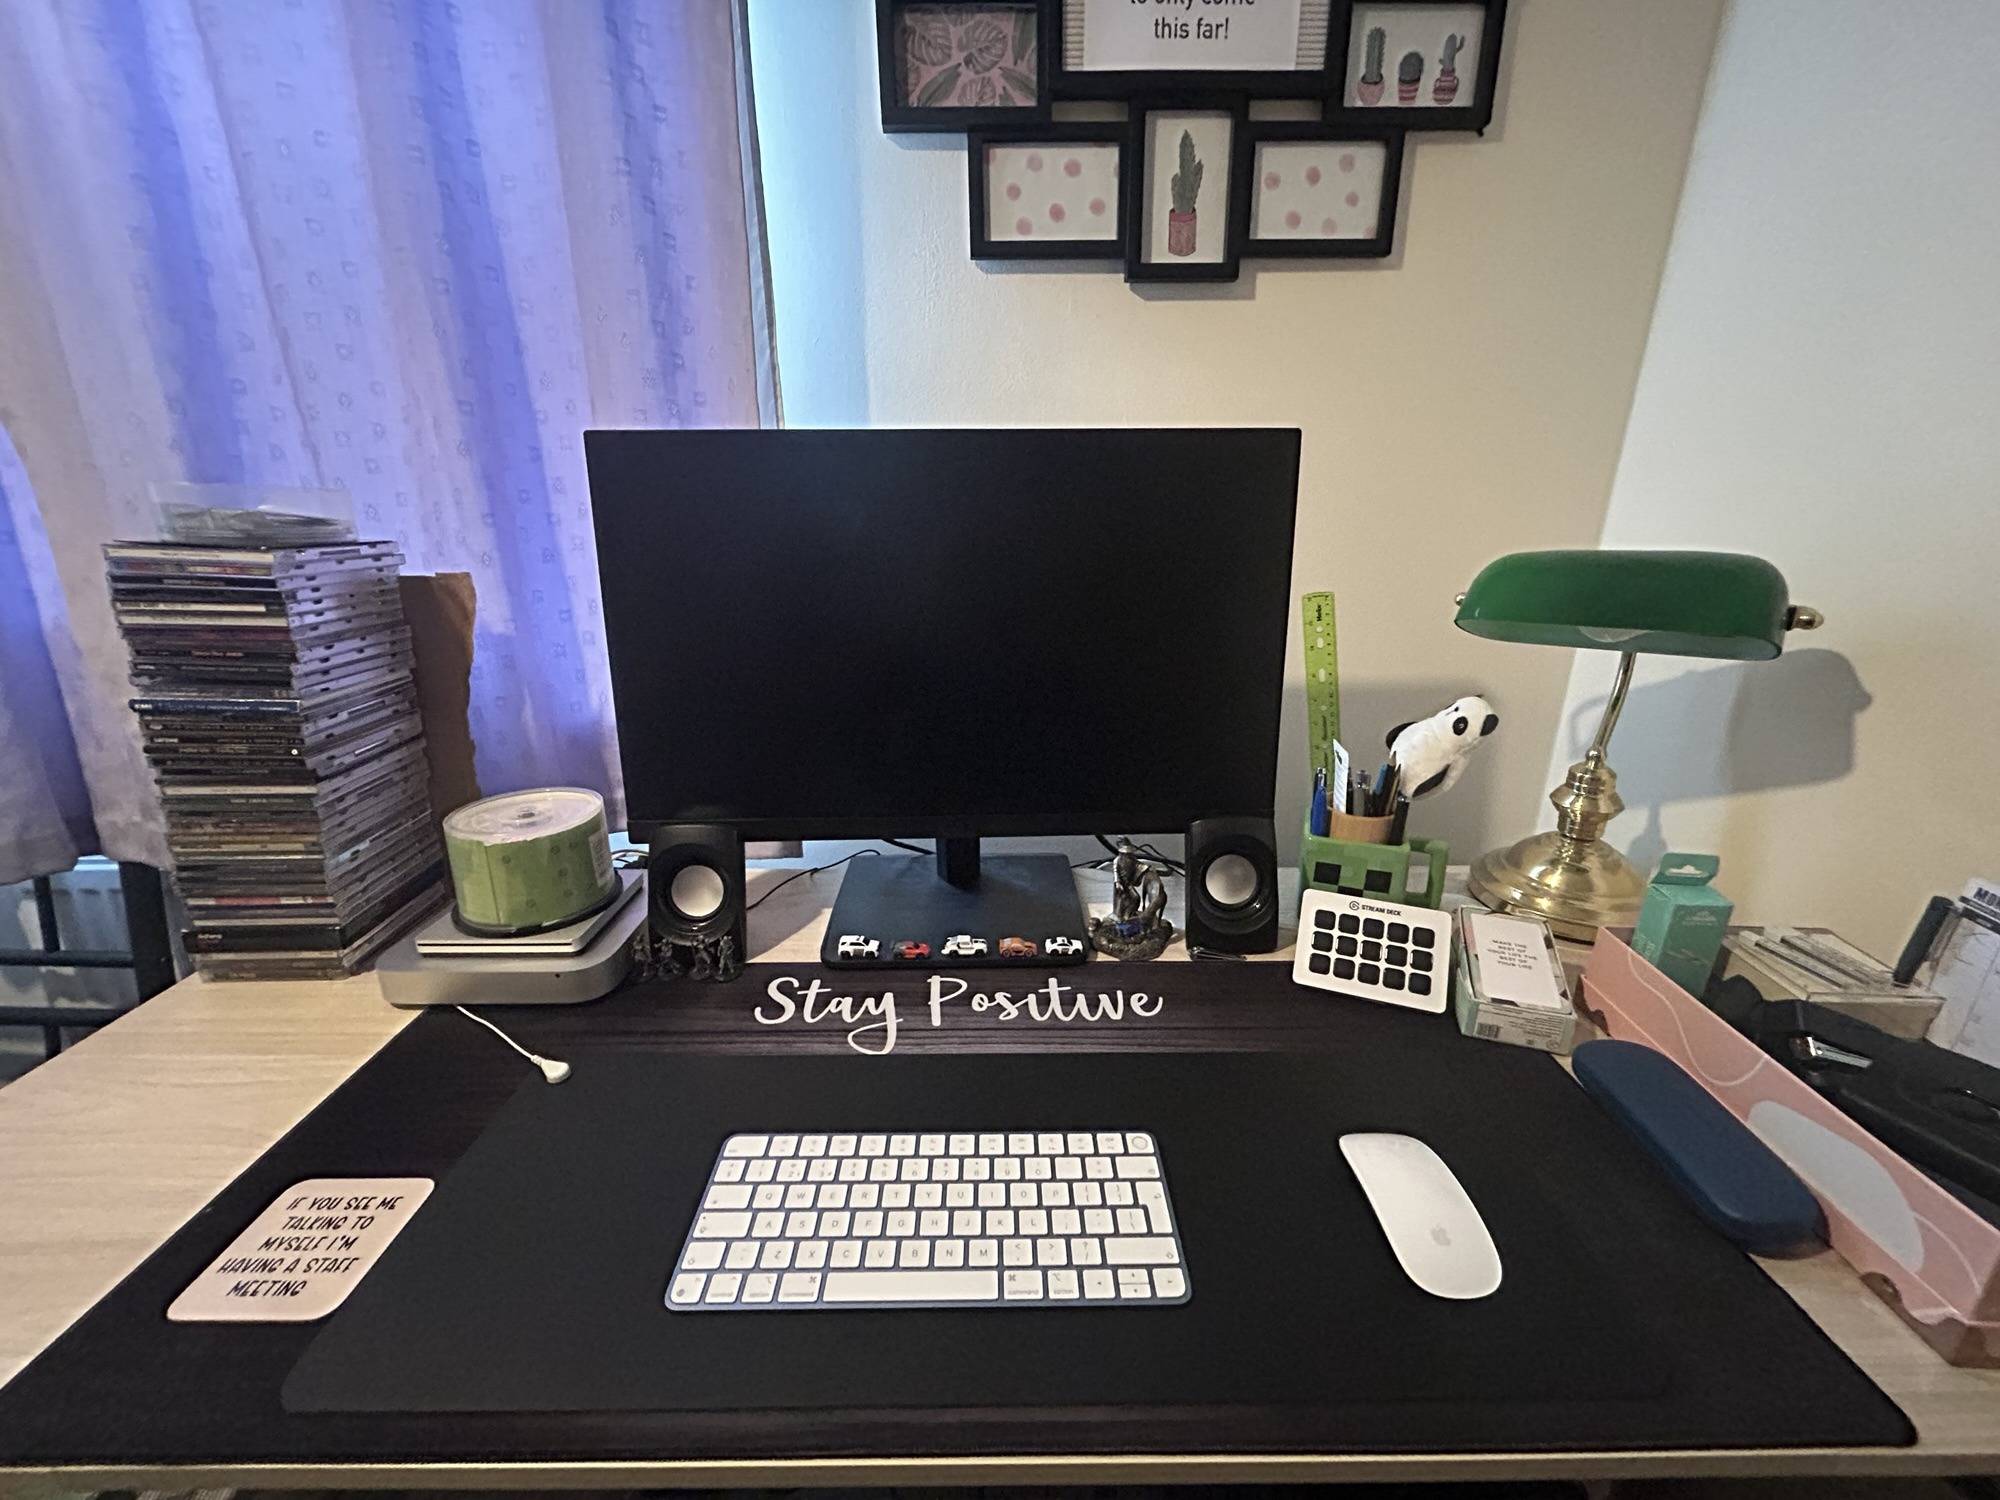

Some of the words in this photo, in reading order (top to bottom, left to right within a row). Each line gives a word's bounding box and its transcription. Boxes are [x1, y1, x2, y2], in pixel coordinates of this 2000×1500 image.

[1154, 16, 1189, 39] this
[1196, 16, 1229, 39] far!
[1361, 904, 1386, 914] STREAM
[1386, 908, 1402, 917] DECK
[754, 976, 903, 1055] Stay
[927, 974, 1164, 1027] Positive
[286, 1196, 307, 1211] IF
[308, 1196, 343, 1211] YOU
[343, 1196, 378, 1211] SEE
[375, 1196, 404, 1211] ME
[281, 1216, 348, 1231] TALKING
[351, 1216, 375, 1231] TO
[257, 1236, 329, 1251] MYSELF
[326, 1235, 361, 1251] I'M
[216, 1257, 284, 1274] HAVING
[283, 1257, 302, 1273] A
[303, 1257, 361, 1273] STAFF
[225, 1280, 307, 1297] MEETING
